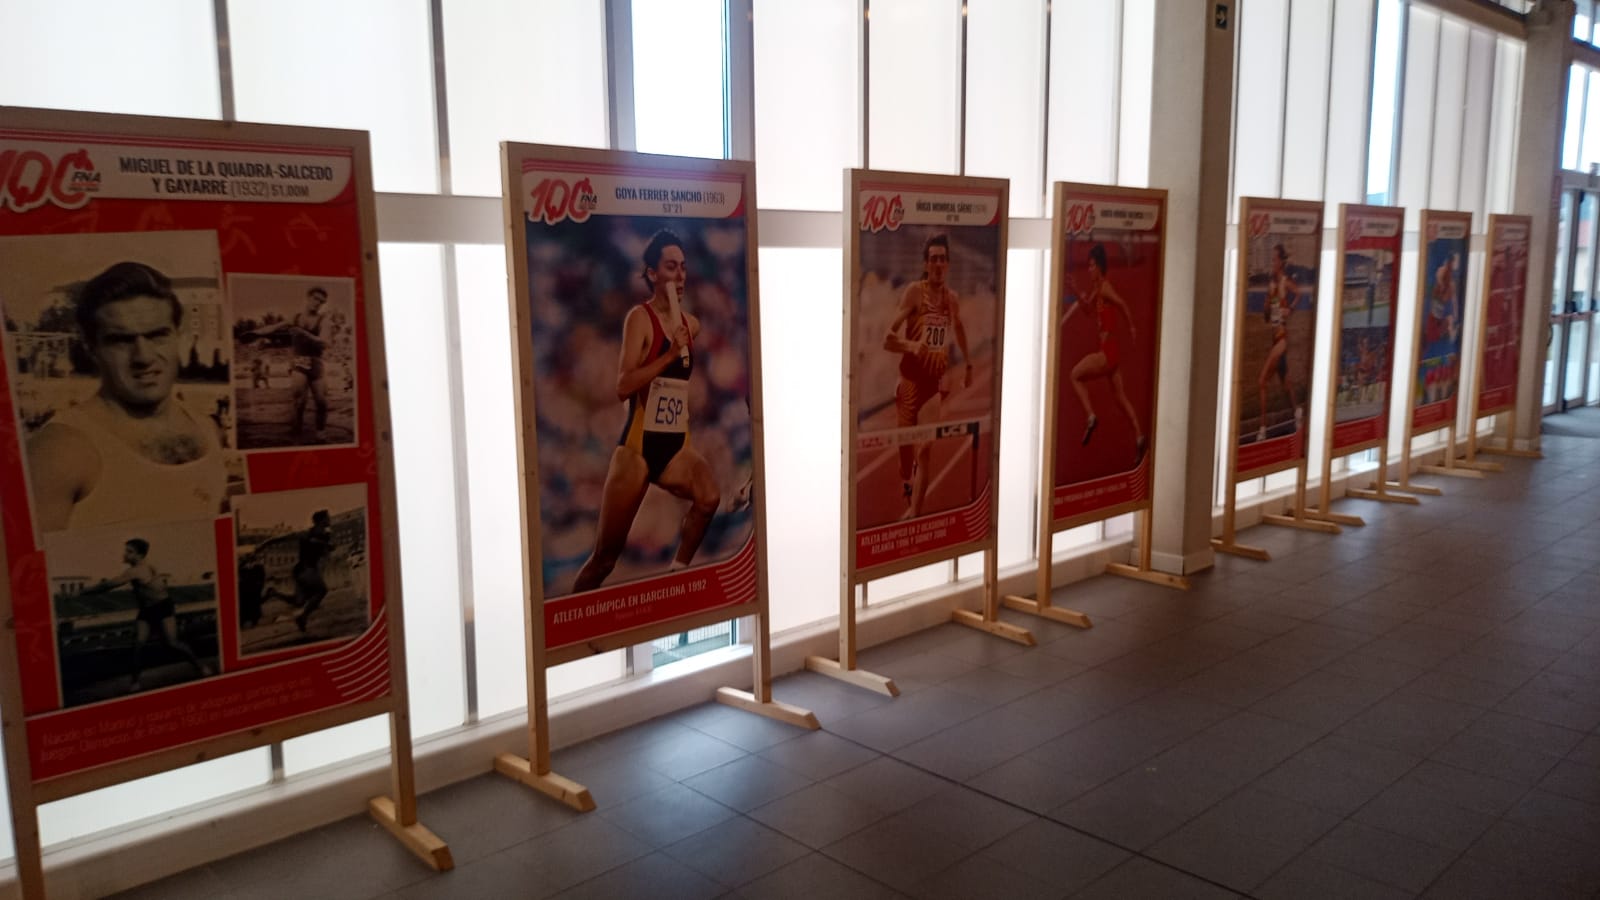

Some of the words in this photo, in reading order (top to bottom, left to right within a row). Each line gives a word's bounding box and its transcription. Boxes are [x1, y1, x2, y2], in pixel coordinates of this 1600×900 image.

[70, 171, 102, 183] FNA
[119, 156, 173, 175] MIGUEL
[177, 159, 195, 176] DE
[197, 160, 215, 177] LA
[218, 161, 334, 182] QUADRA-SALCEDO
[151, 177, 161, 193] Y
[165, 177, 228, 196] GAYARRE
[230, 180, 270, 199] (1932)
[615, 187, 638, 201] GOYA
[638, 188, 669, 202] FERRER
[670, 190, 702, 204] SANCHO
[926, 327, 945, 346] 200
[655, 396, 683, 425] ESP
[553, 607, 584, 626] ATLETA
[585, 596, 627, 618] OLÍMPICA
[627, 593, 640, 609] EN
[640, 582, 686, 605] BARCELONA
[688, 578, 708, 594] 1992
